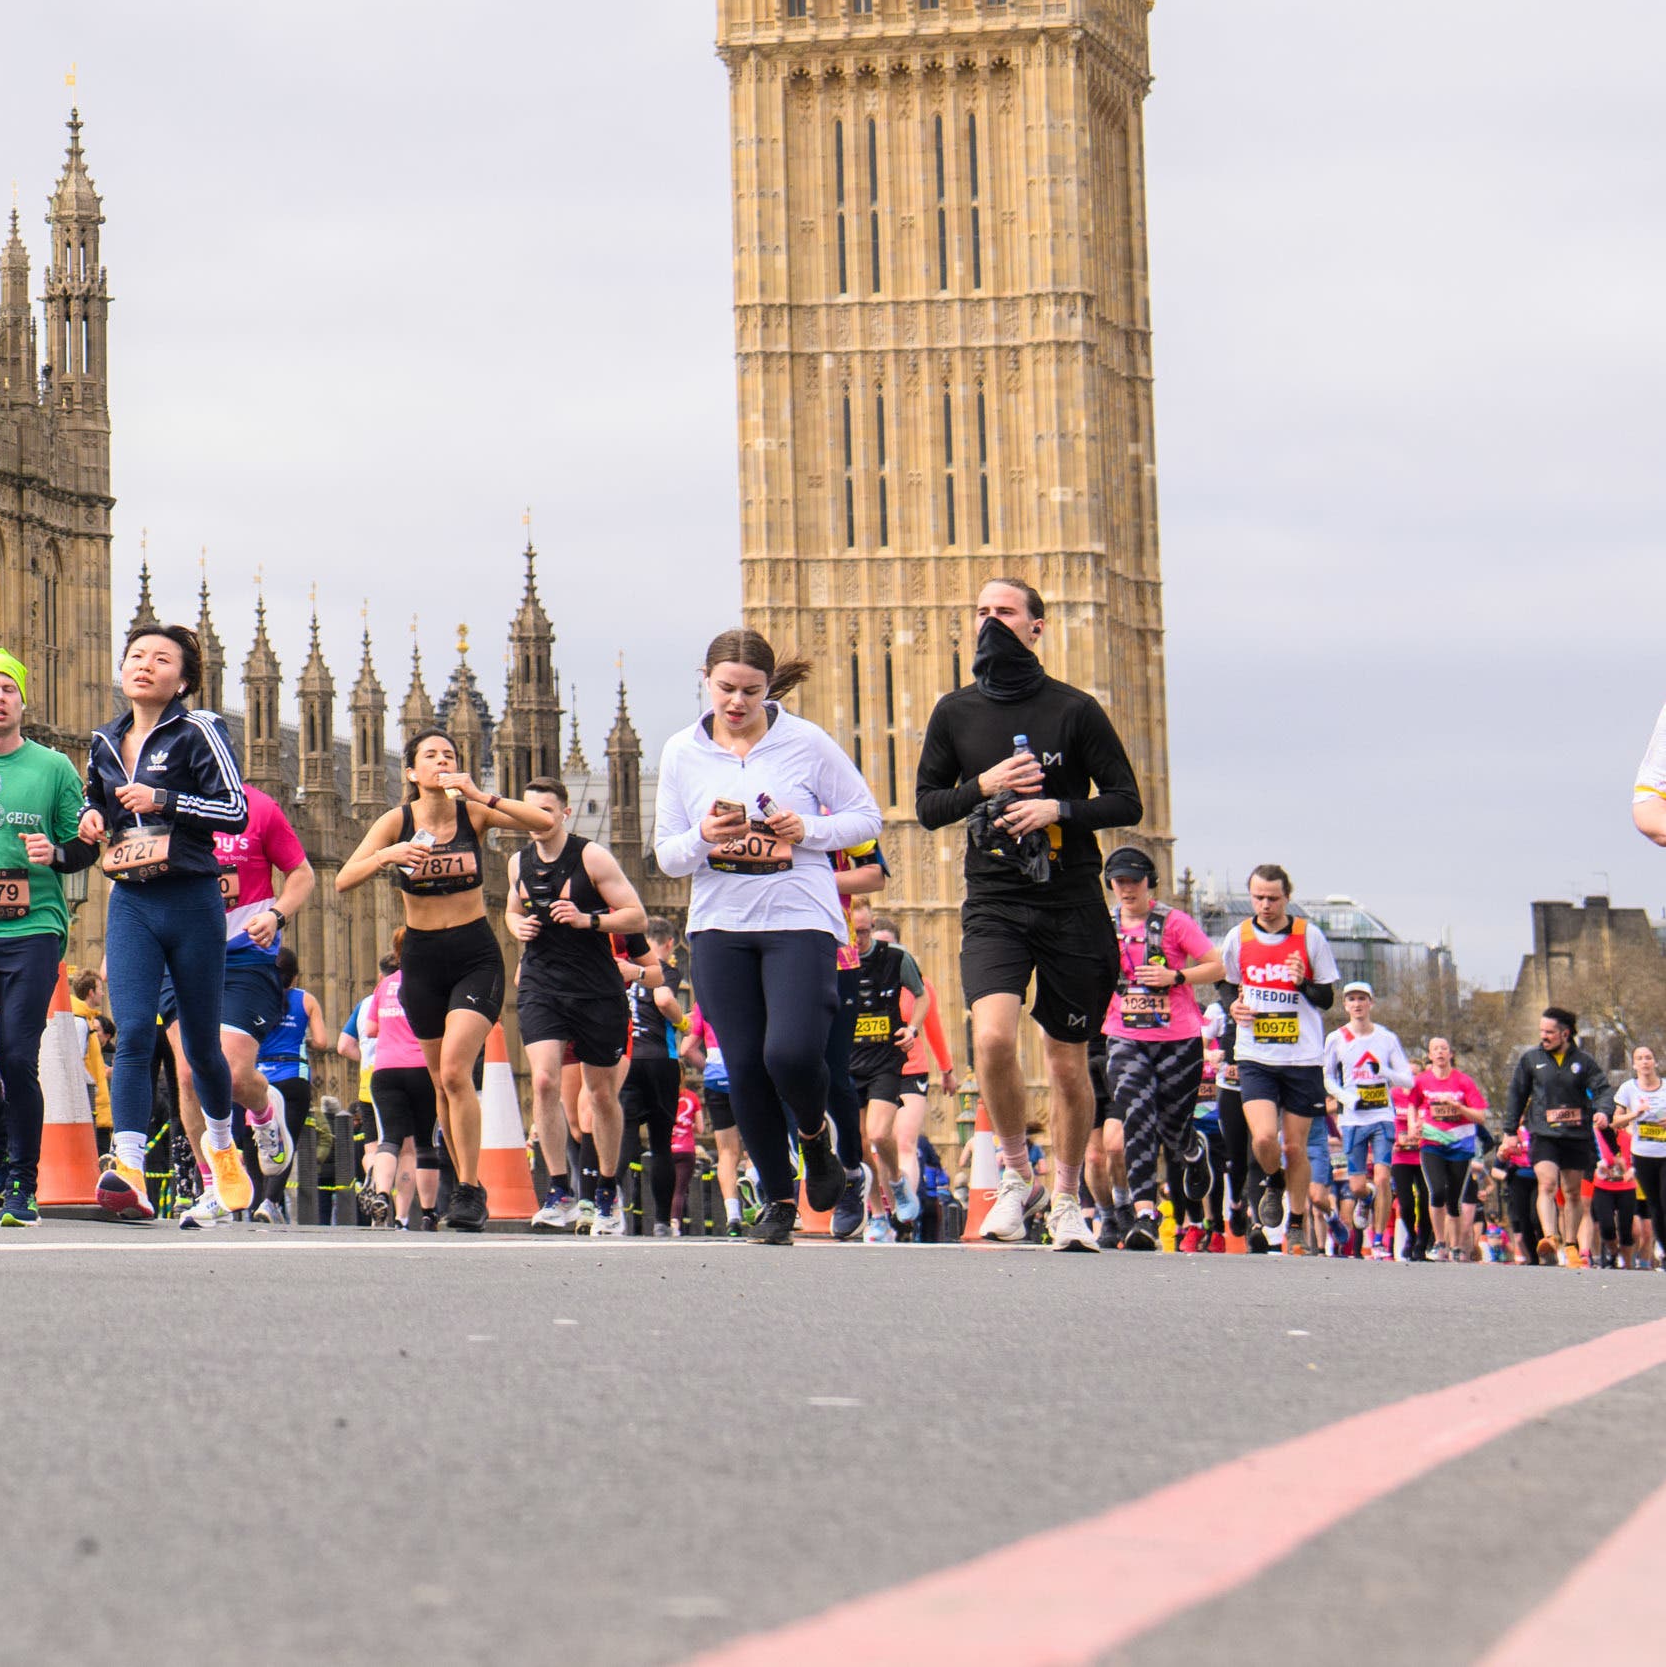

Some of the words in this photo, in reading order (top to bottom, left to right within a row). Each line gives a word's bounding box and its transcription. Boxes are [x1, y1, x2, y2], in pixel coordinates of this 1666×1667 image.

[6, 811, 42, 827] GEIST
[113, 839, 158, 865] 9727
[1249, 988, 1300, 1005] FREDDIE
[1255, 1021, 1297, 1034] 10975
